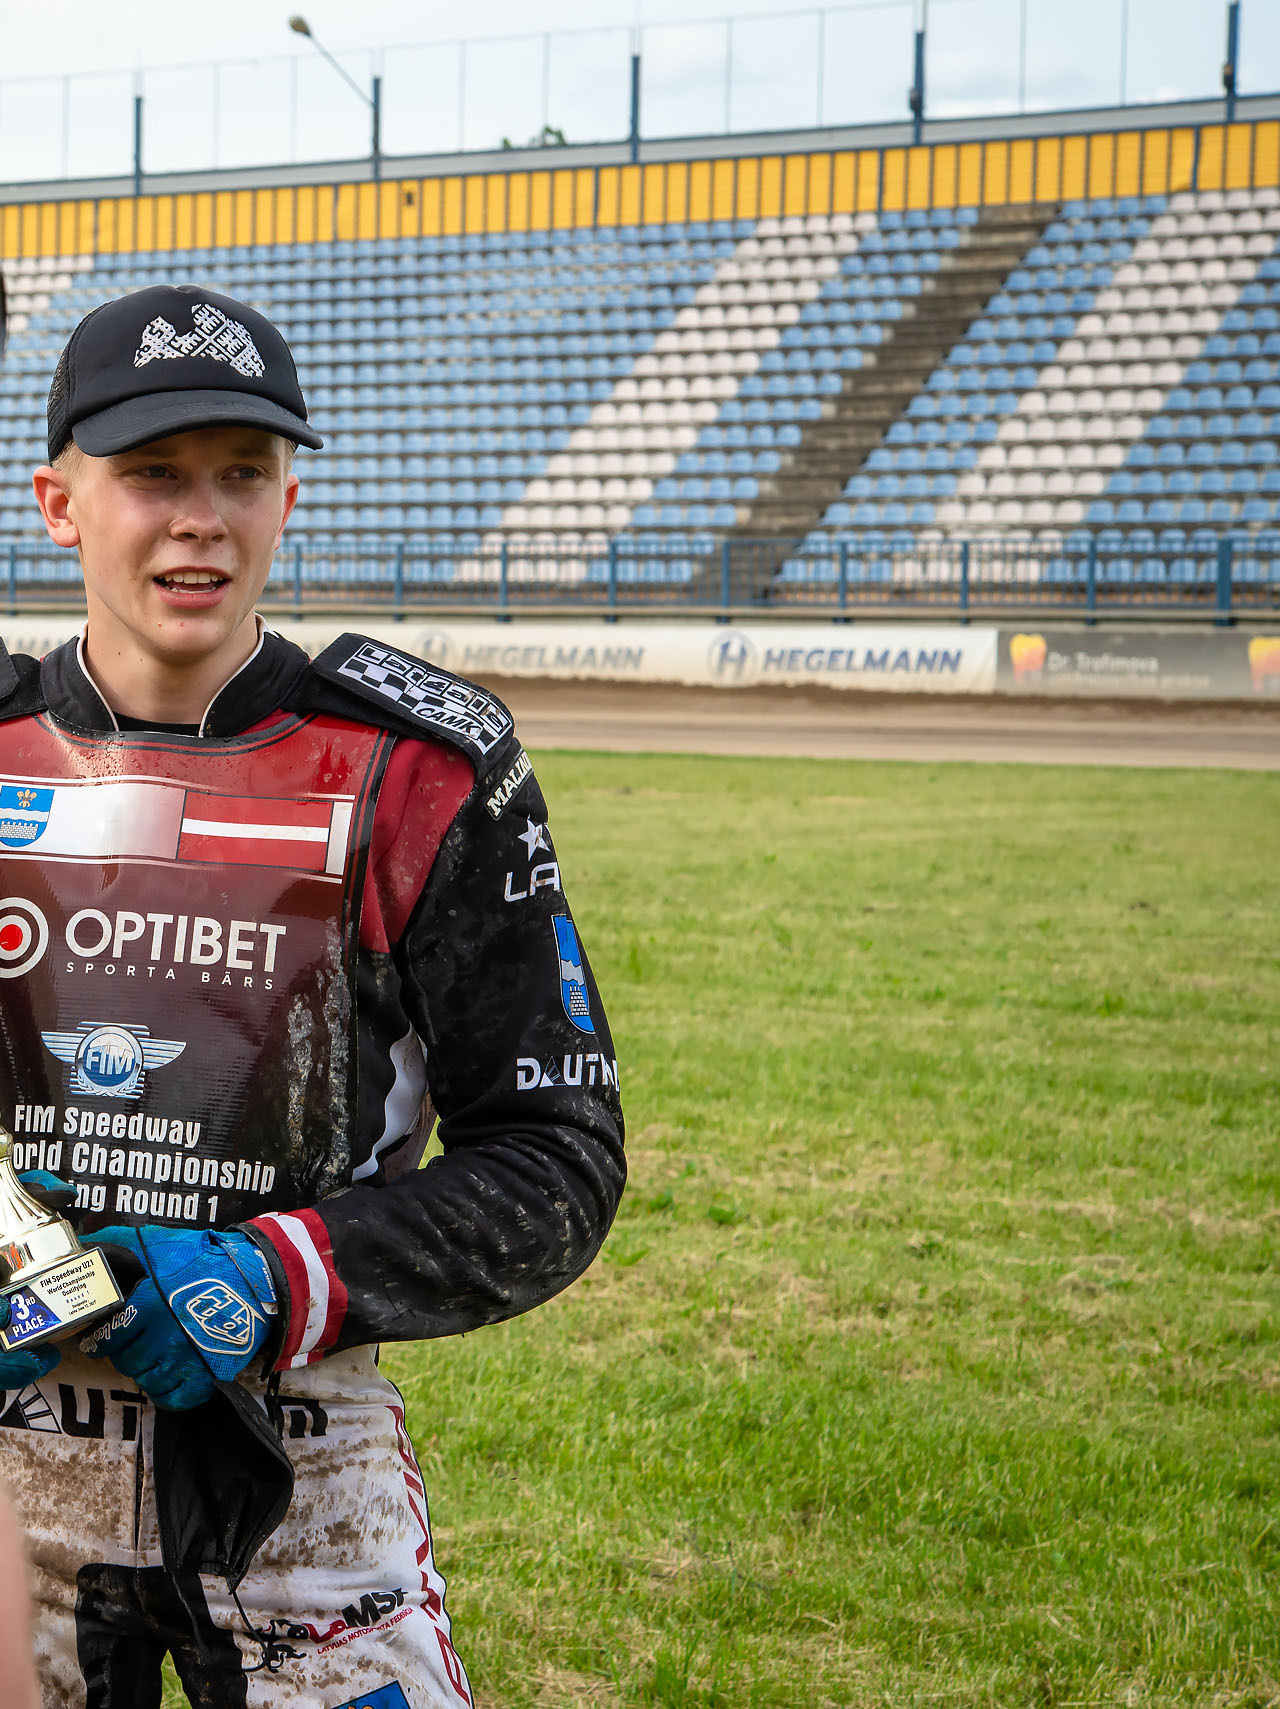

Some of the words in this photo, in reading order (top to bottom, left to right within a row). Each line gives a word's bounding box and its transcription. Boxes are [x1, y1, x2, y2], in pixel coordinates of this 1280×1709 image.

[462, 644, 645, 671] HEGELMANN
[762, 648, 963, 673] HEGELMANN
[414, 706, 480, 737] CAMK
[65, 908, 287, 973] OPTIBET
[66, 962, 176, 980] SPORTA
[201, 971, 273, 990] BĀRS
[86, 1043, 134, 1076] FIM
[14, 1105, 56, 1133] FIM
[63, 1107, 201, 1149] Speedway
[13, 1140, 63, 1171] orld
[71, 1142, 276, 1195] Championship
[115, 1184, 200, 1223] Round
[207, 1195, 219, 1223] 1
[47, 1284, 63, 1295] World
[62, 1270, 96, 1289] Championship
[51, 1265, 82, 1283] Speedway
[82, 1259, 94, 1270] U21
[11, 1314, 46, 1338] PLACE
[112, 1304, 138, 1330] Troy
